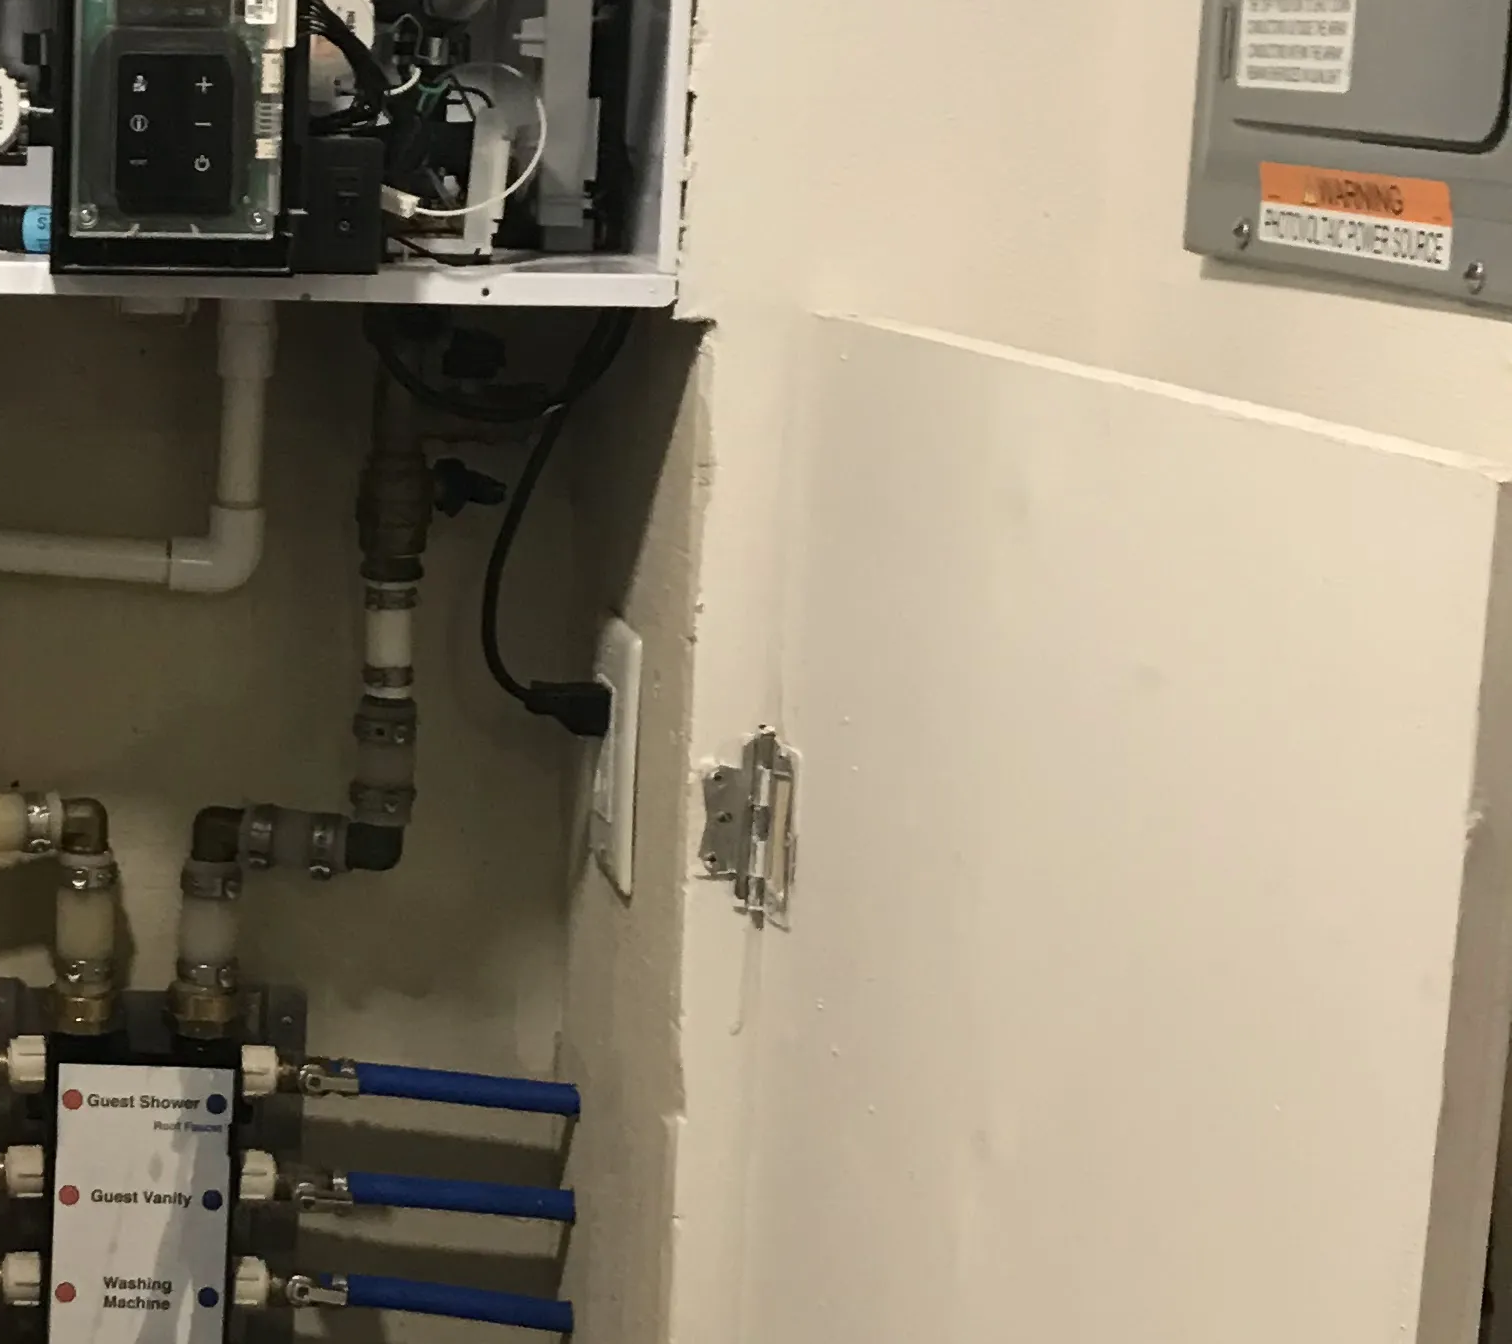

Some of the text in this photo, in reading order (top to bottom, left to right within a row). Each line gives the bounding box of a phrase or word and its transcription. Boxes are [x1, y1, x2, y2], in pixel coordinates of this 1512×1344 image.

[1319, 177, 1403, 215] WARNING
[1391, 227, 1443, 264] SOURCE
[87, 1093, 200, 1110] Guest Shower
[91, 1189, 192, 1208] Guest Vanity
[103, 1276, 172, 1294] Washing
[103, 1295, 170, 1311] Machine
